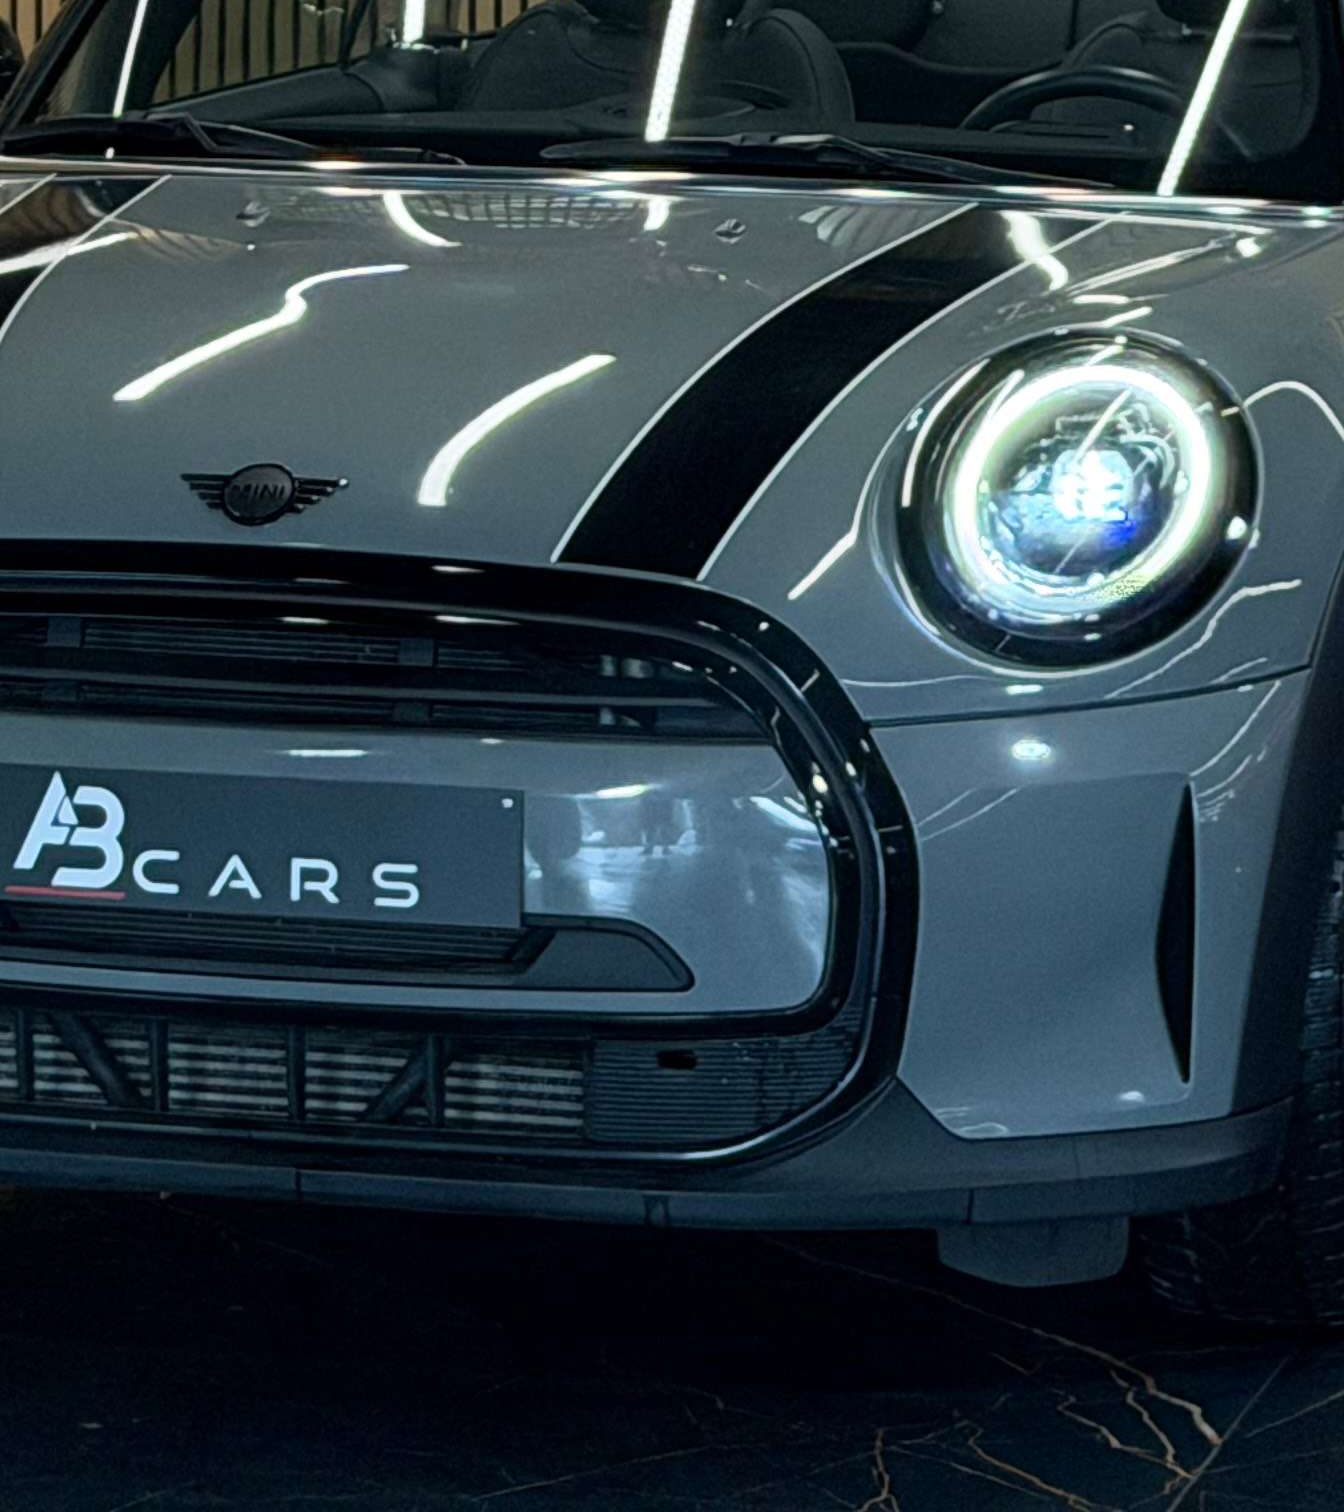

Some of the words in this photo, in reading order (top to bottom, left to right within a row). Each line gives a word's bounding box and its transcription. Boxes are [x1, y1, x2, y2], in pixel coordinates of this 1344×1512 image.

[230, 482, 286, 502] MINI
[13, 771, 125, 888] AB
[132, 850, 420, 908] CARS
